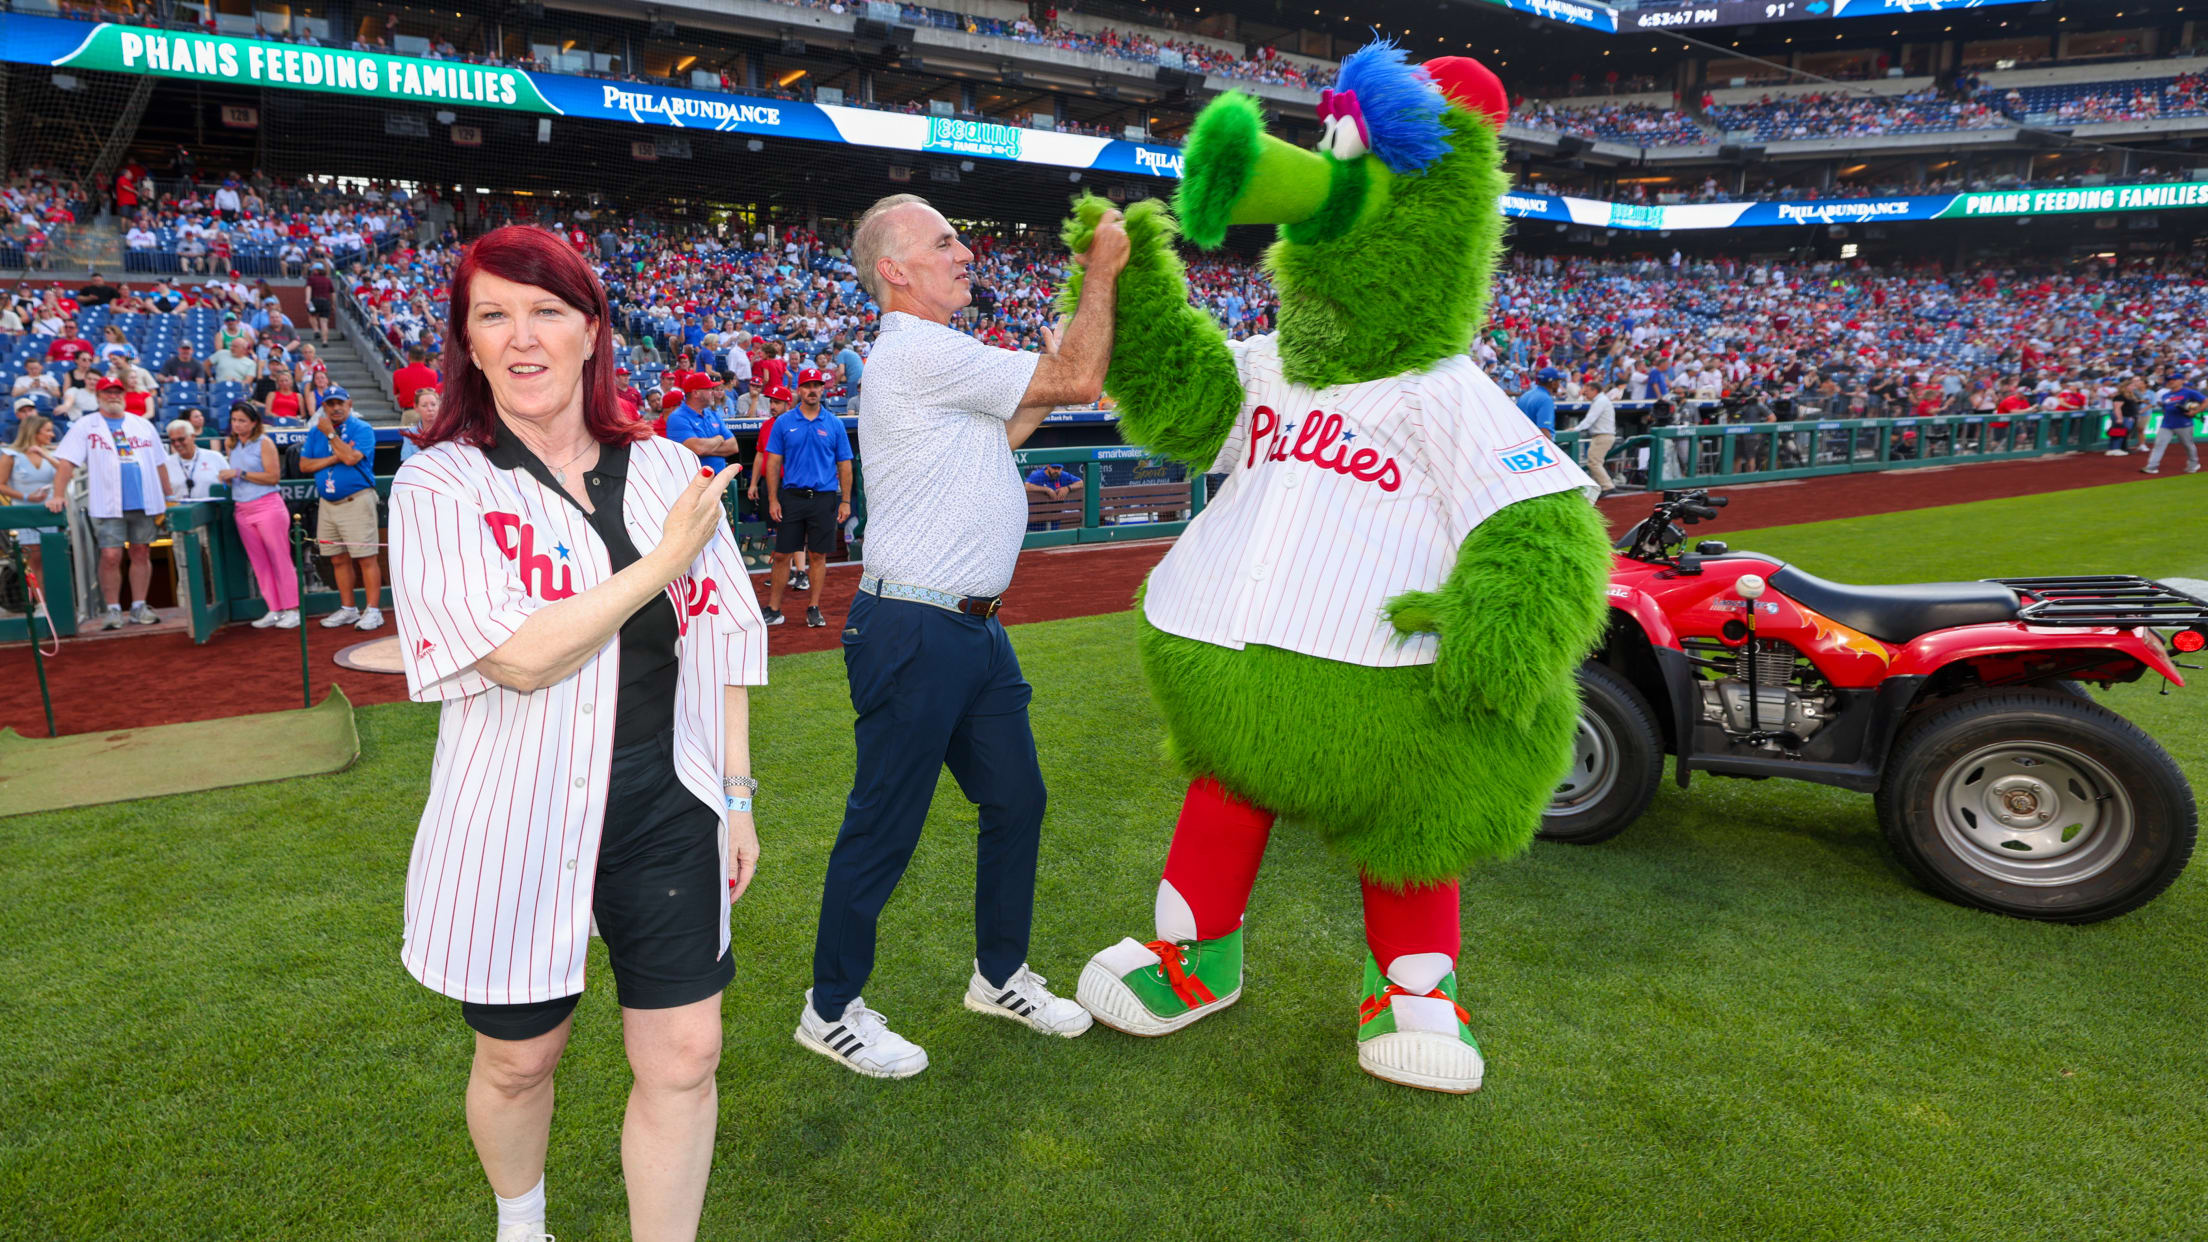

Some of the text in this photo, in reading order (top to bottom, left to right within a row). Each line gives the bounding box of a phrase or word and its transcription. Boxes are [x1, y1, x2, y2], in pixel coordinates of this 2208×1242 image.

[1694, 9, 1718, 24] PM
[120, 32, 517, 105] PHANS FEEDING FAMILIES
[602, 85, 781, 132] PHILABUNDANCE
[1778, 202, 1910, 225] PHILABUNDANCE
[1965, 184, 2208, 215] PHANS FEEDING FAMILIES
[1097, 448, 1142, 459] smartwater
[1246, 405, 1403, 493] Phillies
[1501, 445, 1554, 472] IBX
